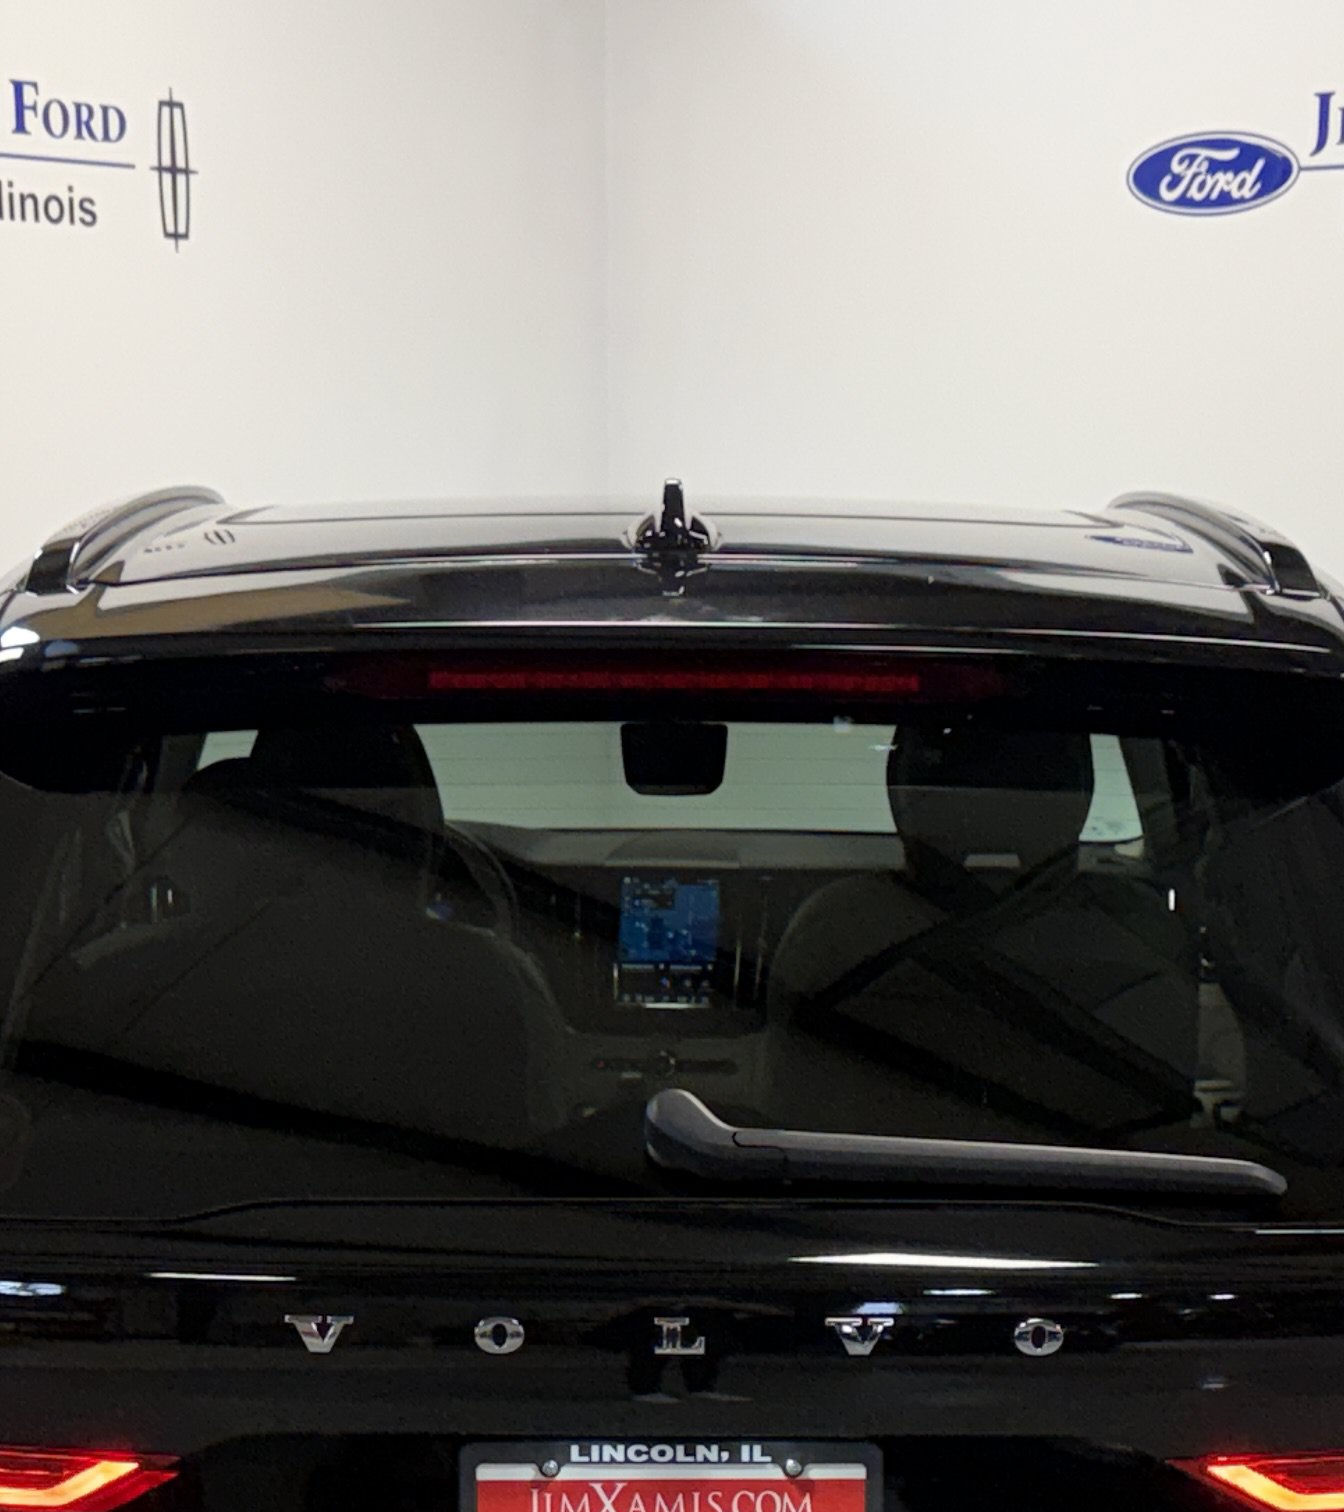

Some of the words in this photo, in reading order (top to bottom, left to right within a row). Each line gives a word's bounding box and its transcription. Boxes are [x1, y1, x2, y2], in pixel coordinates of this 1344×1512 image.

[1159, 146, 1262, 203] Ford
[570, 1444, 729, 1463] LINCOLN,
[740, 1445, 772, 1462] IL
